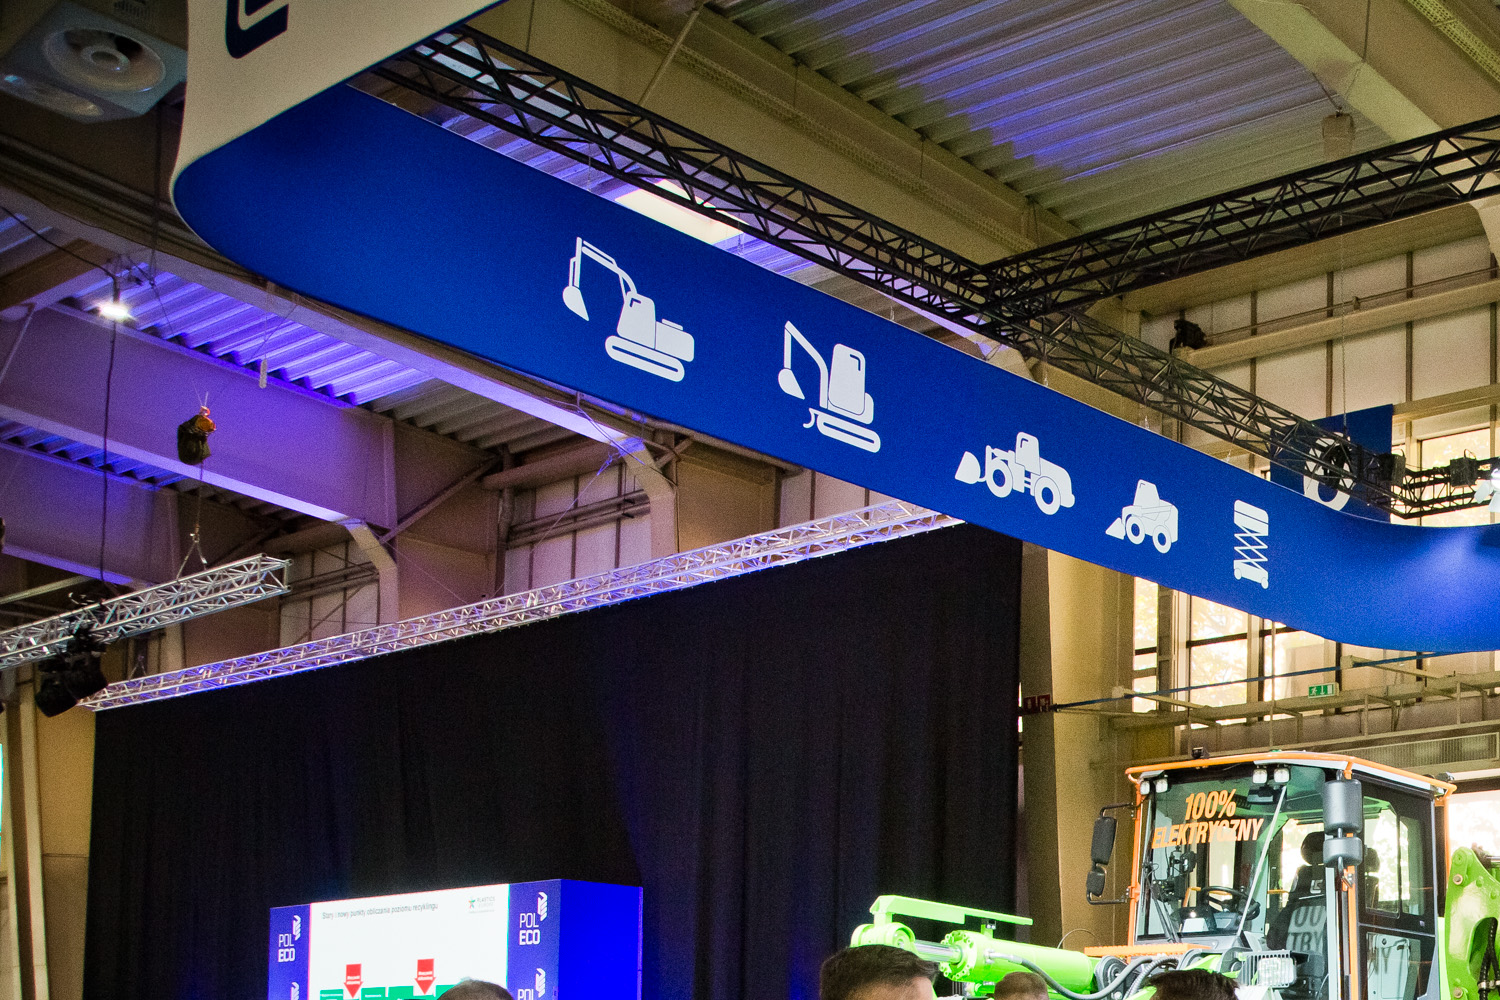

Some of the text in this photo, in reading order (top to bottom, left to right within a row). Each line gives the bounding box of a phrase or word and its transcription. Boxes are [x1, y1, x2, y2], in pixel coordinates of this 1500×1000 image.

[1185, 789, 1237, 820] 100%
[1152, 818, 1264, 849] ELEKTRYCZNY
[519, 913, 539, 928] POL
[278, 933, 294, 948] POL
[519, 929, 541, 945] ECO
[277, 947, 296, 963] ECO
